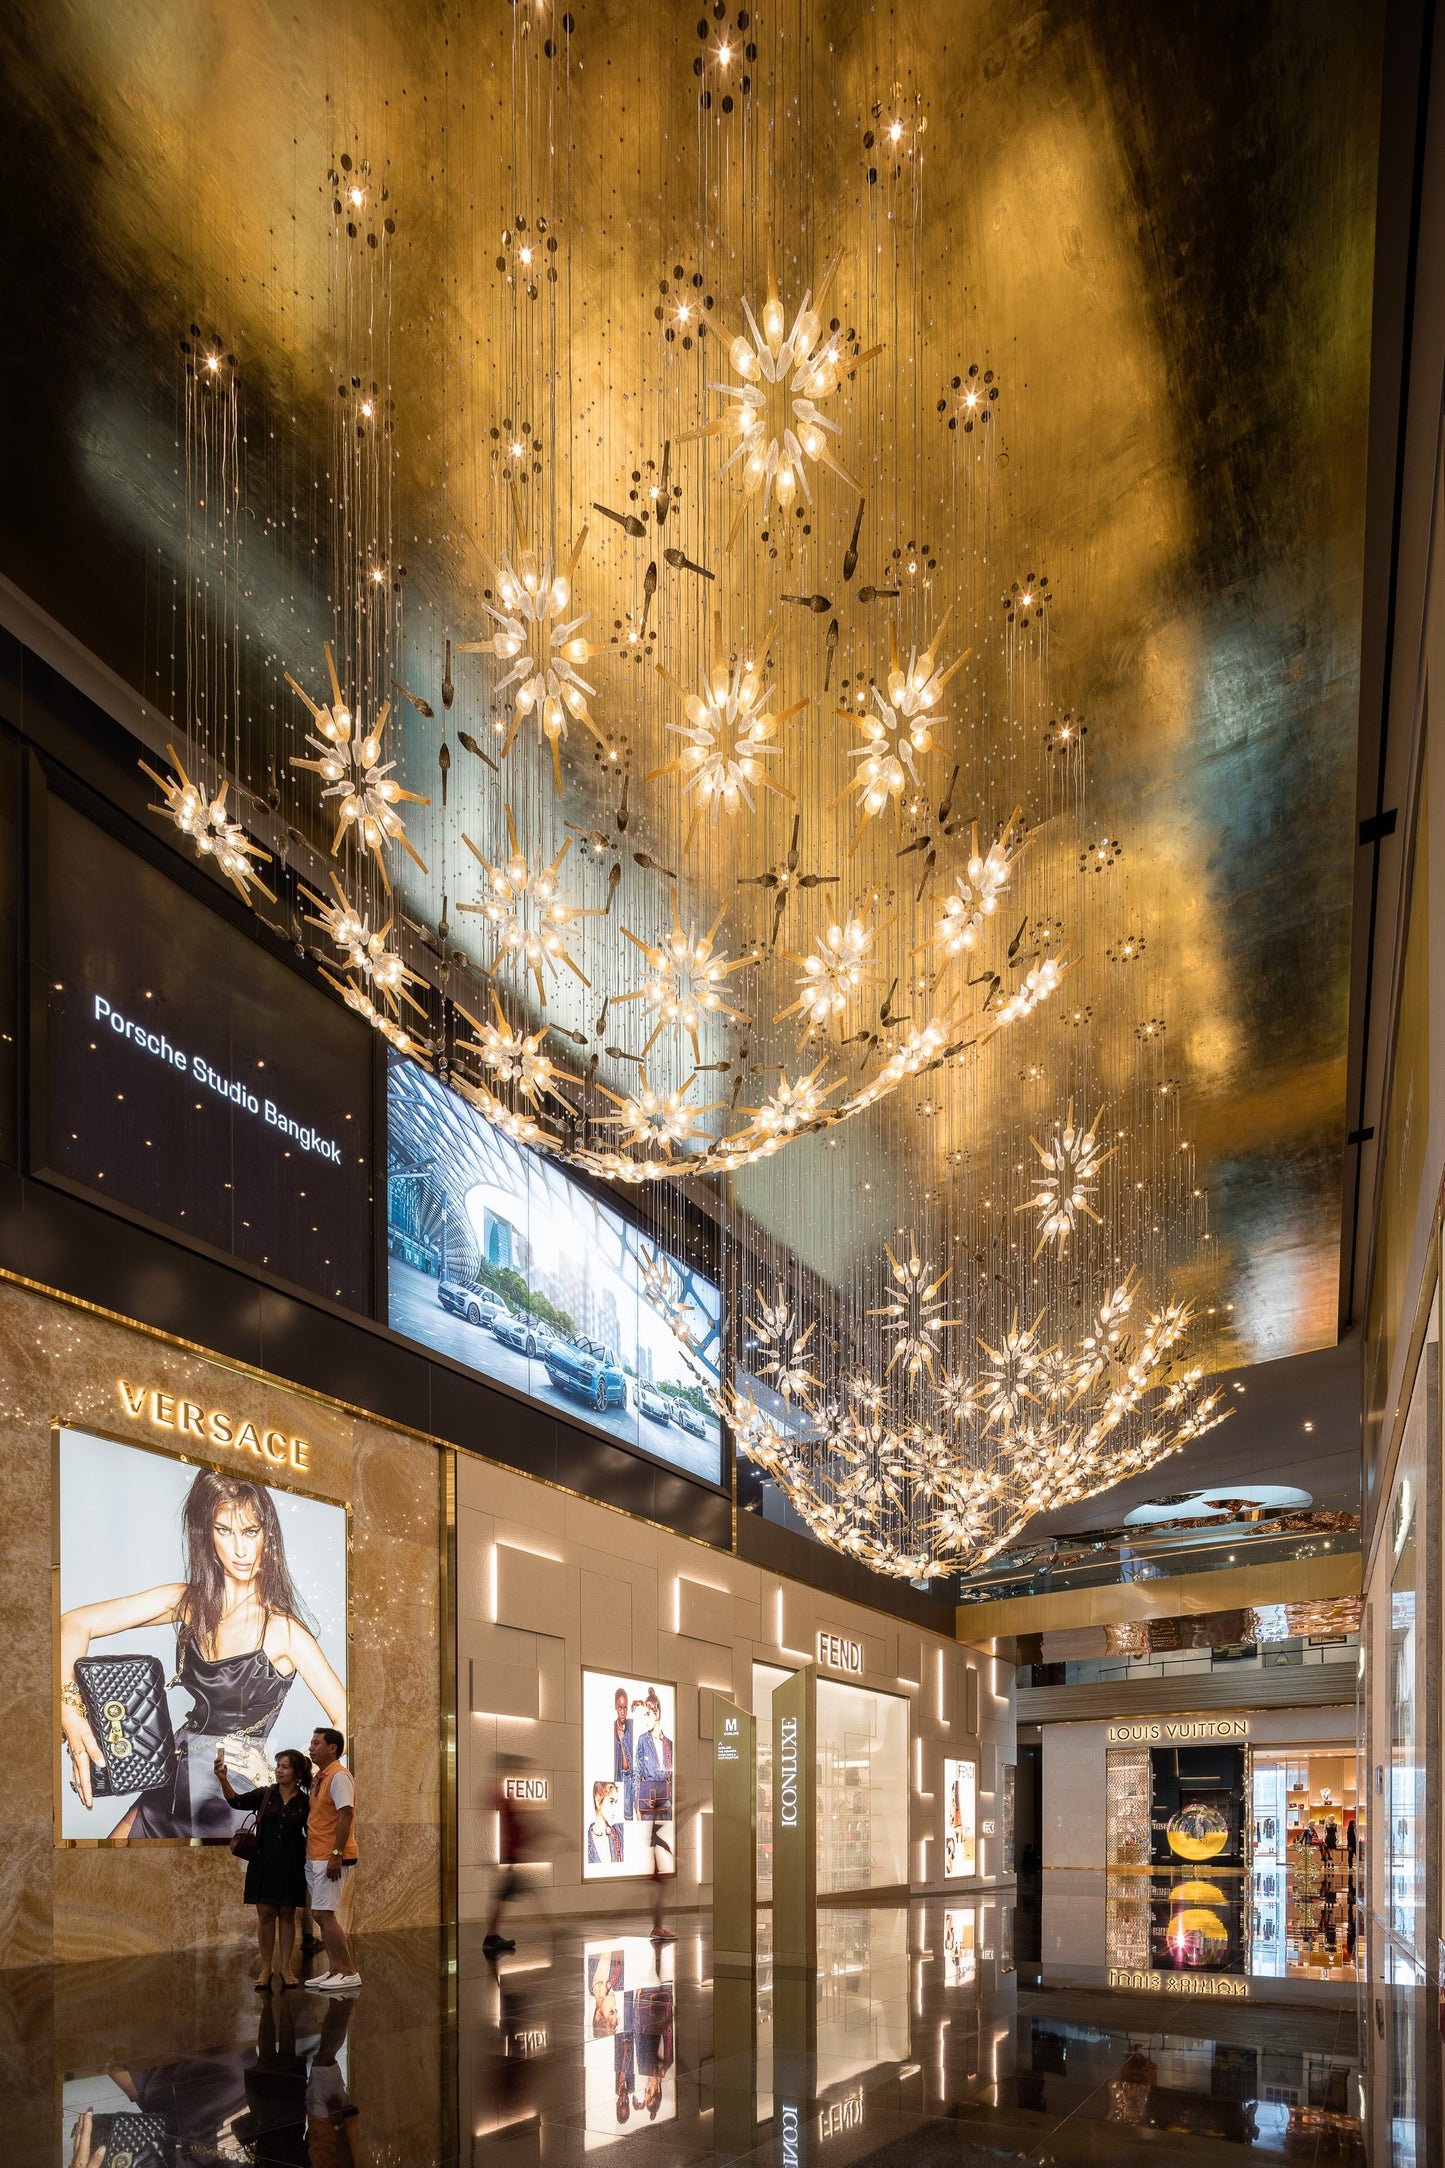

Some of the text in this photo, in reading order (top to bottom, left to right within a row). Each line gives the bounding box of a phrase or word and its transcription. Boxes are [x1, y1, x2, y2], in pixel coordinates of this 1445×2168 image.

[94, 995, 342, 1165] Porsche Studio Bangkok
[118, 1380, 311, 1468] VERSACE
[819, 1631, 864, 1674] FENDI
[725, 1718, 737, 1731] M
[1110, 1720, 1248, 1741] LOUIS VUITTON
[506, 1779, 548, 1798] FENDI
[781, 1717, 798, 1828] ICONLUXE
